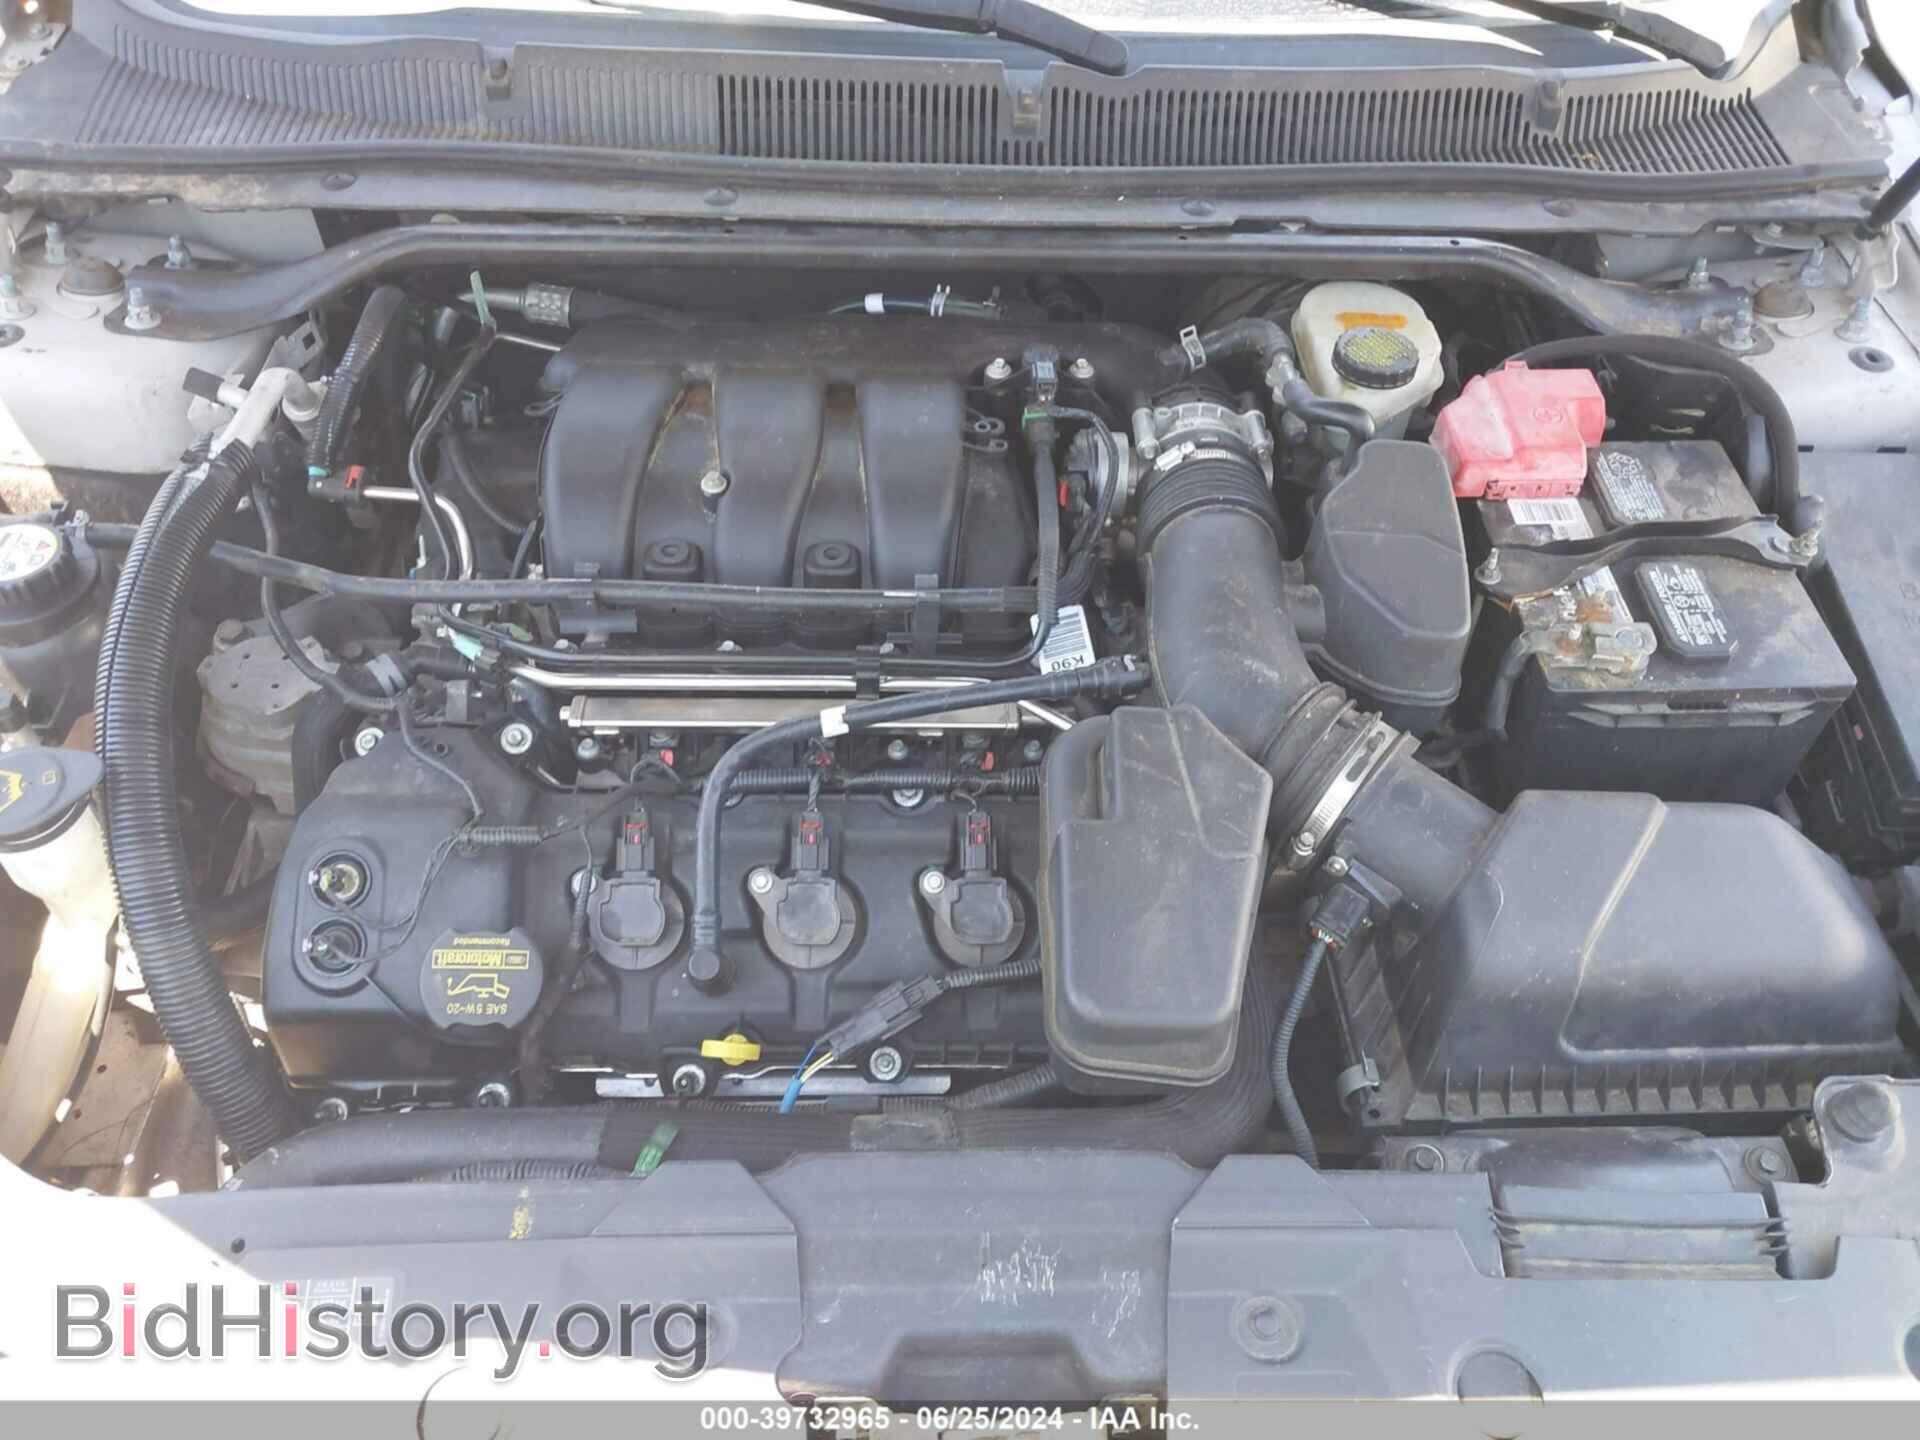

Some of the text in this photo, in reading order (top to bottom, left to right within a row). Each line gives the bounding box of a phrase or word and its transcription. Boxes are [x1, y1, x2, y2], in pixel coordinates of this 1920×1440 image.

[1051, 654, 1085, 672] K90
[437, 951, 503, 967] Motorcraft
[446, 1003, 508, 1015] SAE 5W-20
